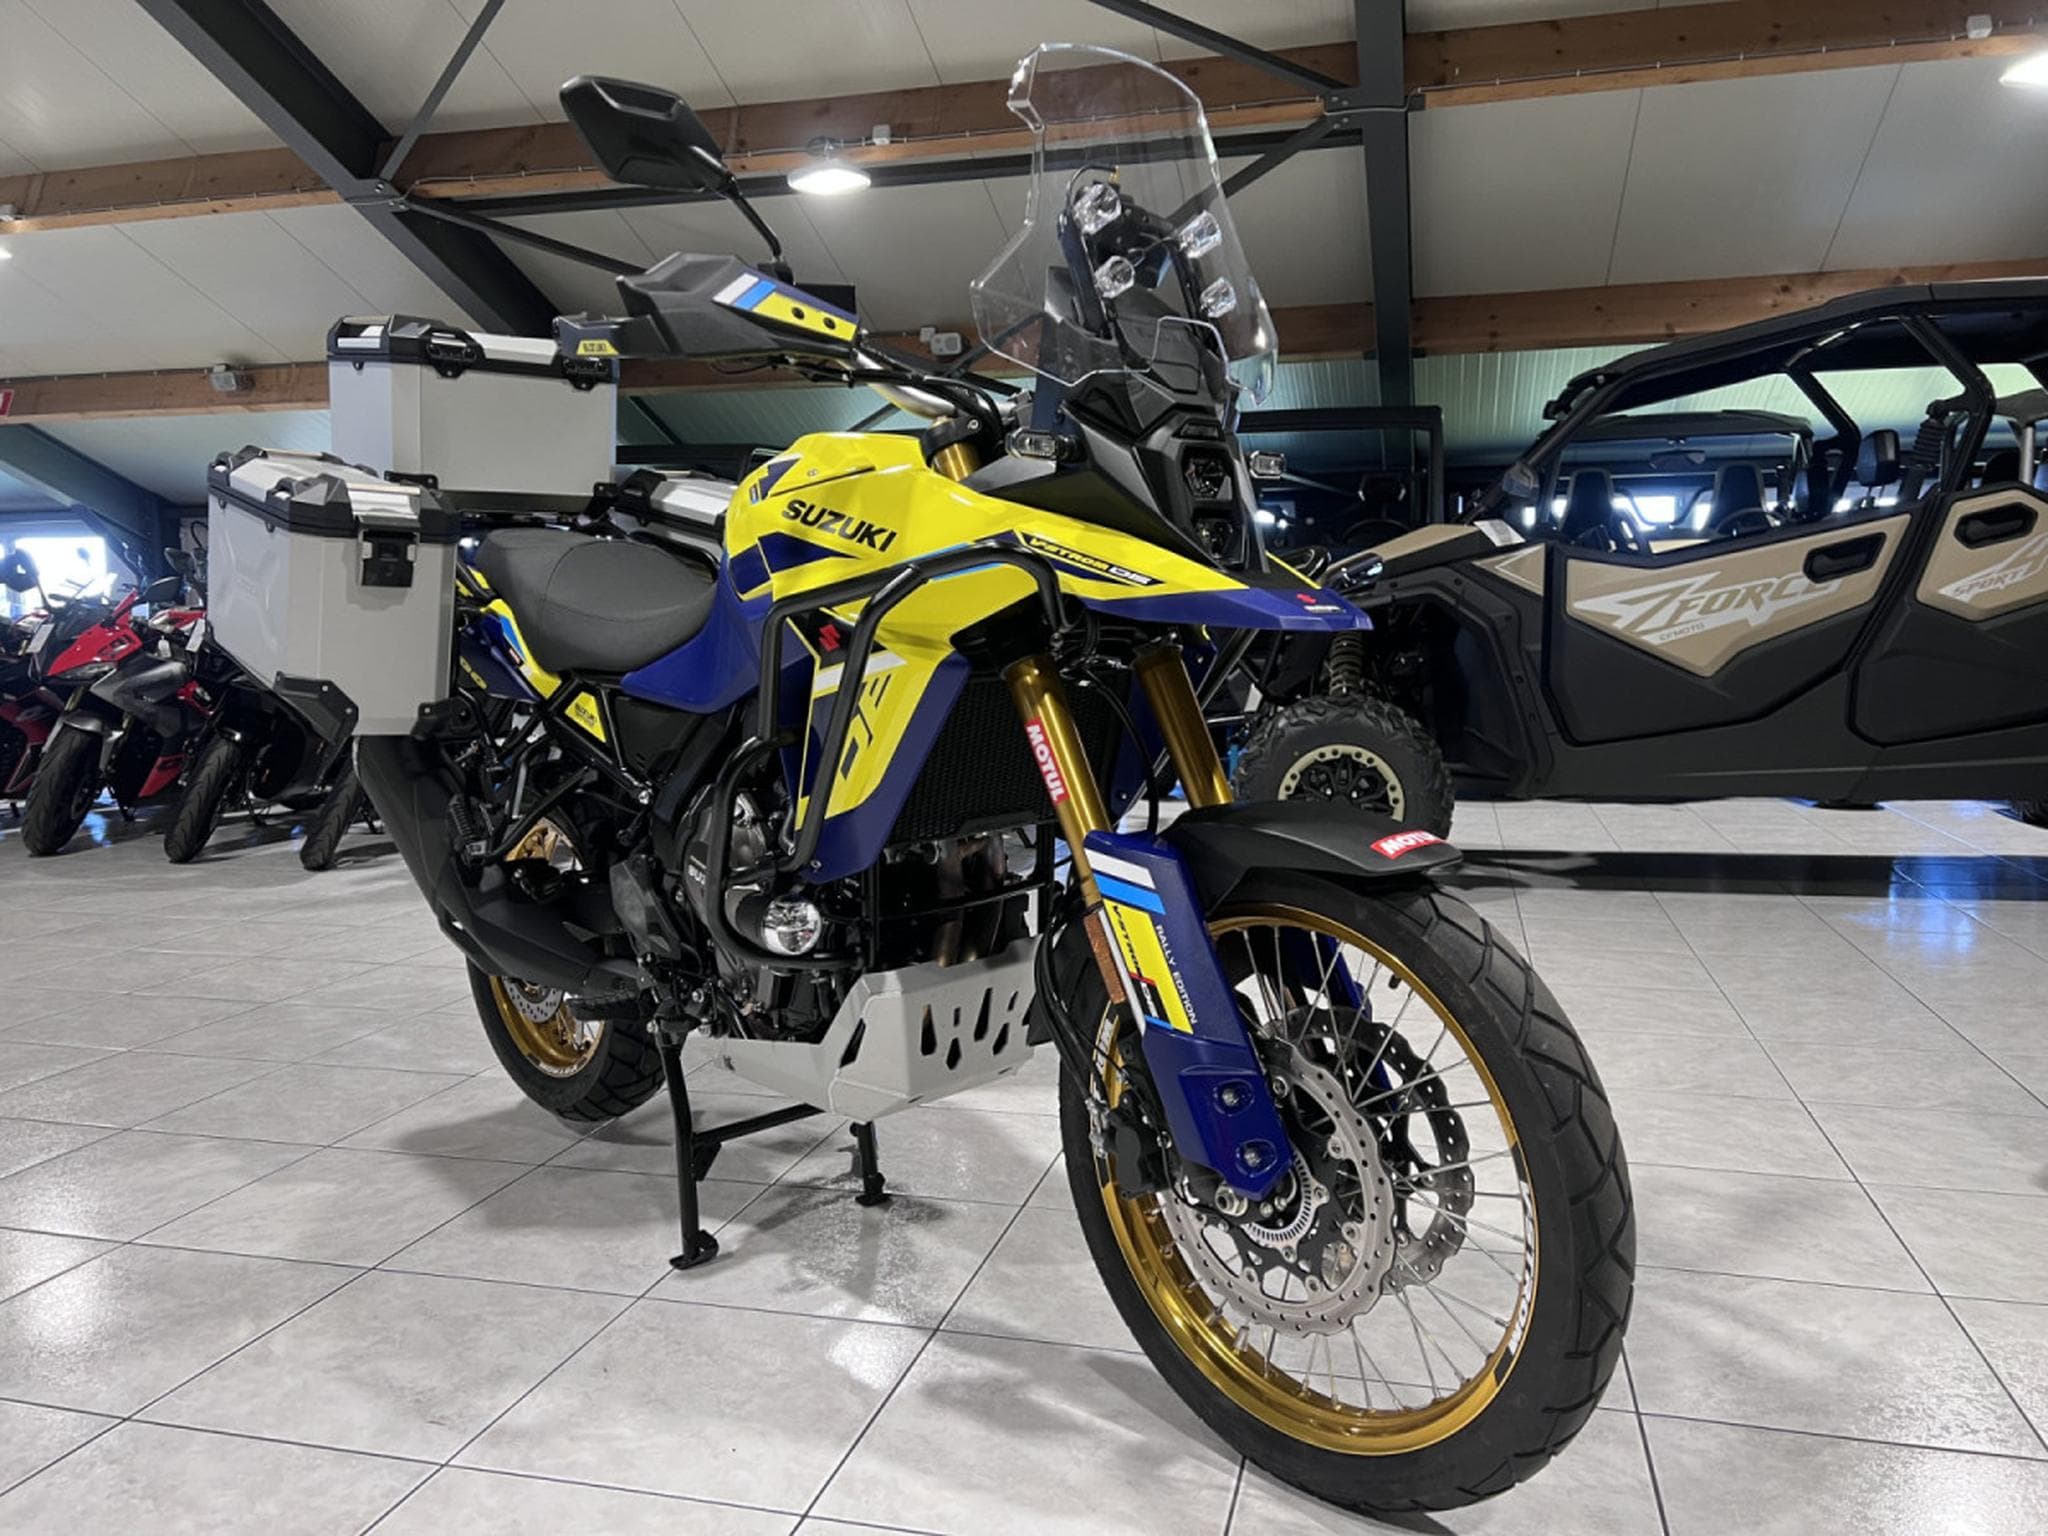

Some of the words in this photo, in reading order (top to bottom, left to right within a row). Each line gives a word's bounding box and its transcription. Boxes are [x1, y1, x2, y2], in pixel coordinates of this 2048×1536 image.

[782, 499, 897, 552] SUZUKI
[1026, 725, 1065, 802] MOTUL
[1155, 924, 1176, 967] RALLY
[1173, 971, 1198, 1024] EDITION
